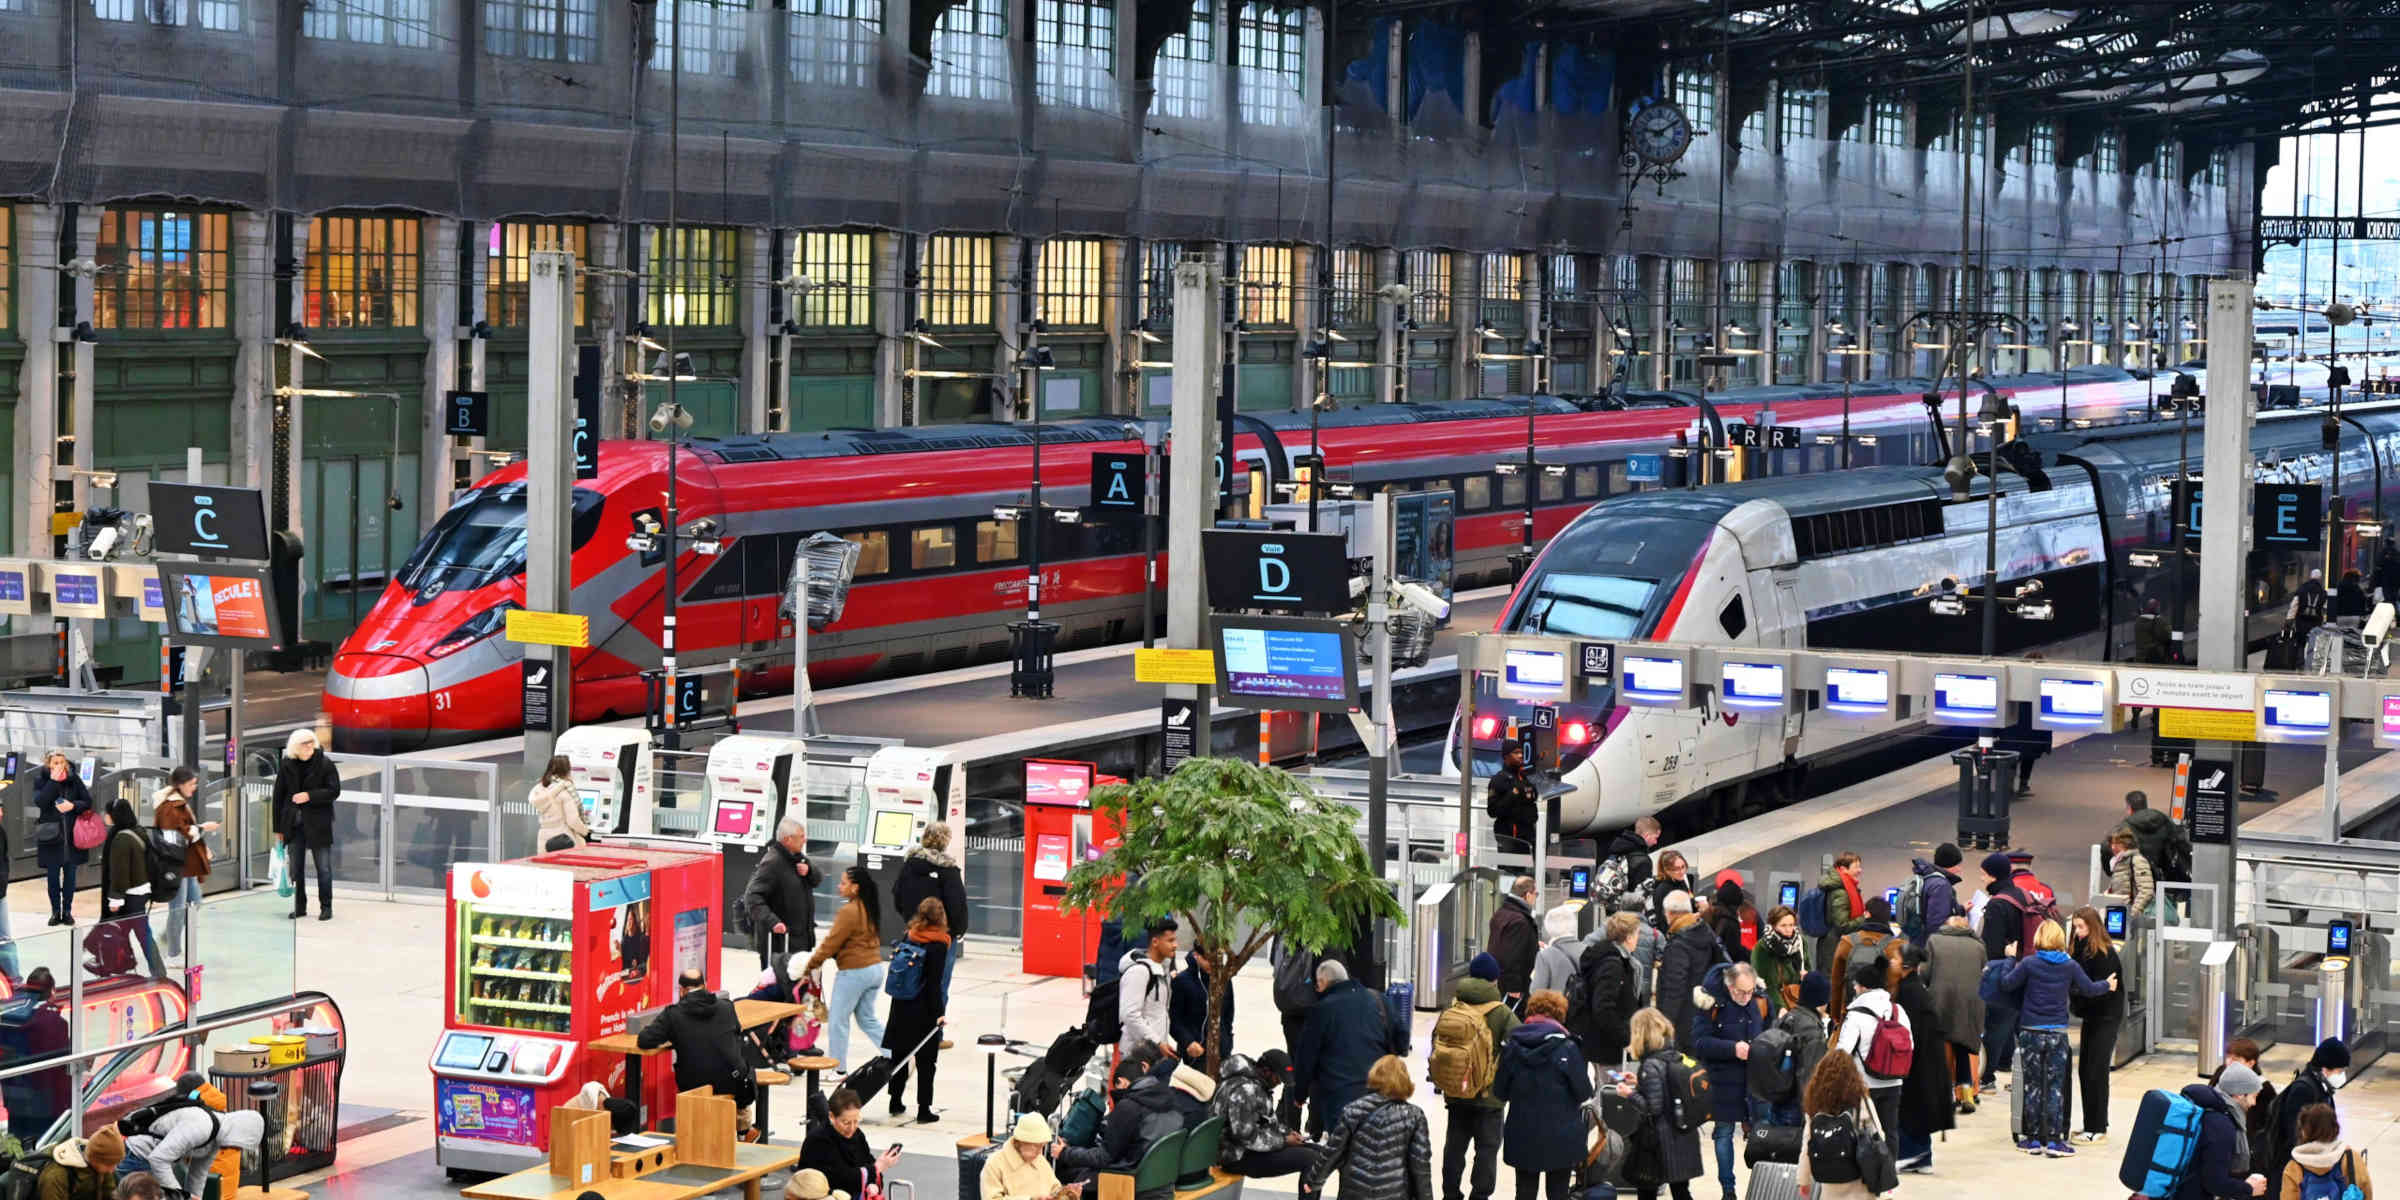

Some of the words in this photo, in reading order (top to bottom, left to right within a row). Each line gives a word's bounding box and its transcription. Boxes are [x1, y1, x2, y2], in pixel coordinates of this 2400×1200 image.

[458, 407, 471, 428] B
[573, 430, 588, 462] C
[1744, 429, 1756, 446] R
[1772, 430, 1785, 447] R
[1107, 472, 1129, 499] A
[194, 508, 219, 541] C
[2278, 505, 2297, 534] E
[1259, 557, 1291, 593] D
[435, 692, 451, 710] 31
[683, 689, 695, 711] C
